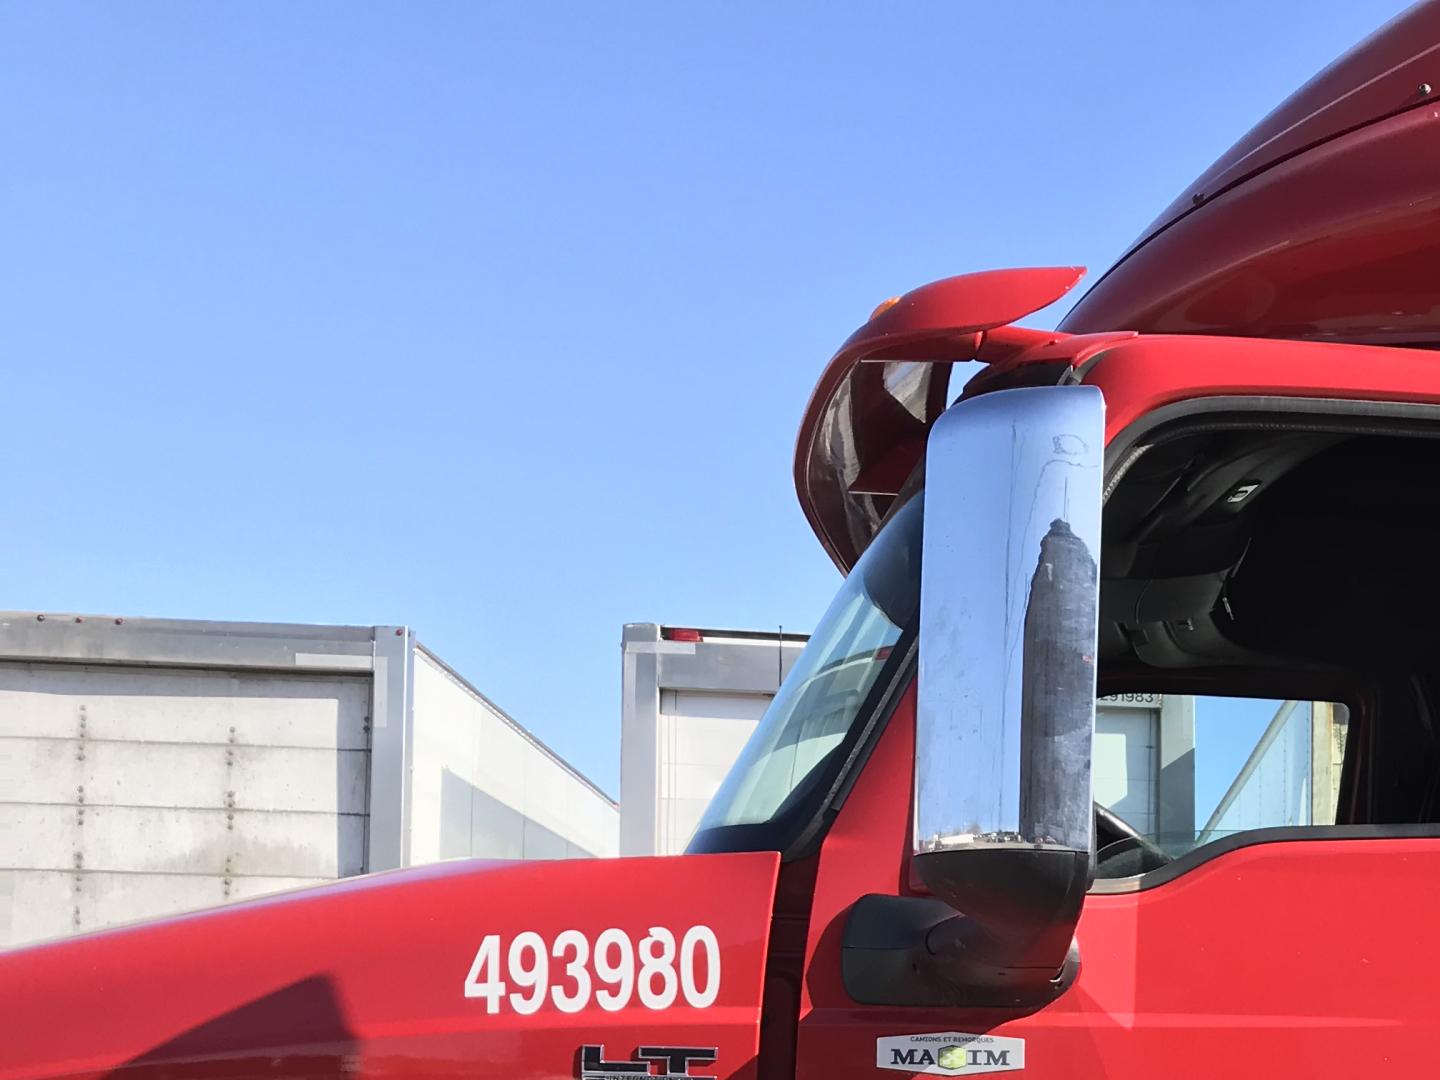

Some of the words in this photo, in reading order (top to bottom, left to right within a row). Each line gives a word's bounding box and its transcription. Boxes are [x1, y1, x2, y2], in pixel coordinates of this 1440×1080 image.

[1100, 693, 1153, 703] 91983
[464, 925, 721, 1015] 493980
[582, 1043, 719, 1077] LT
[890, 1047, 1010, 1067] MAXIM
